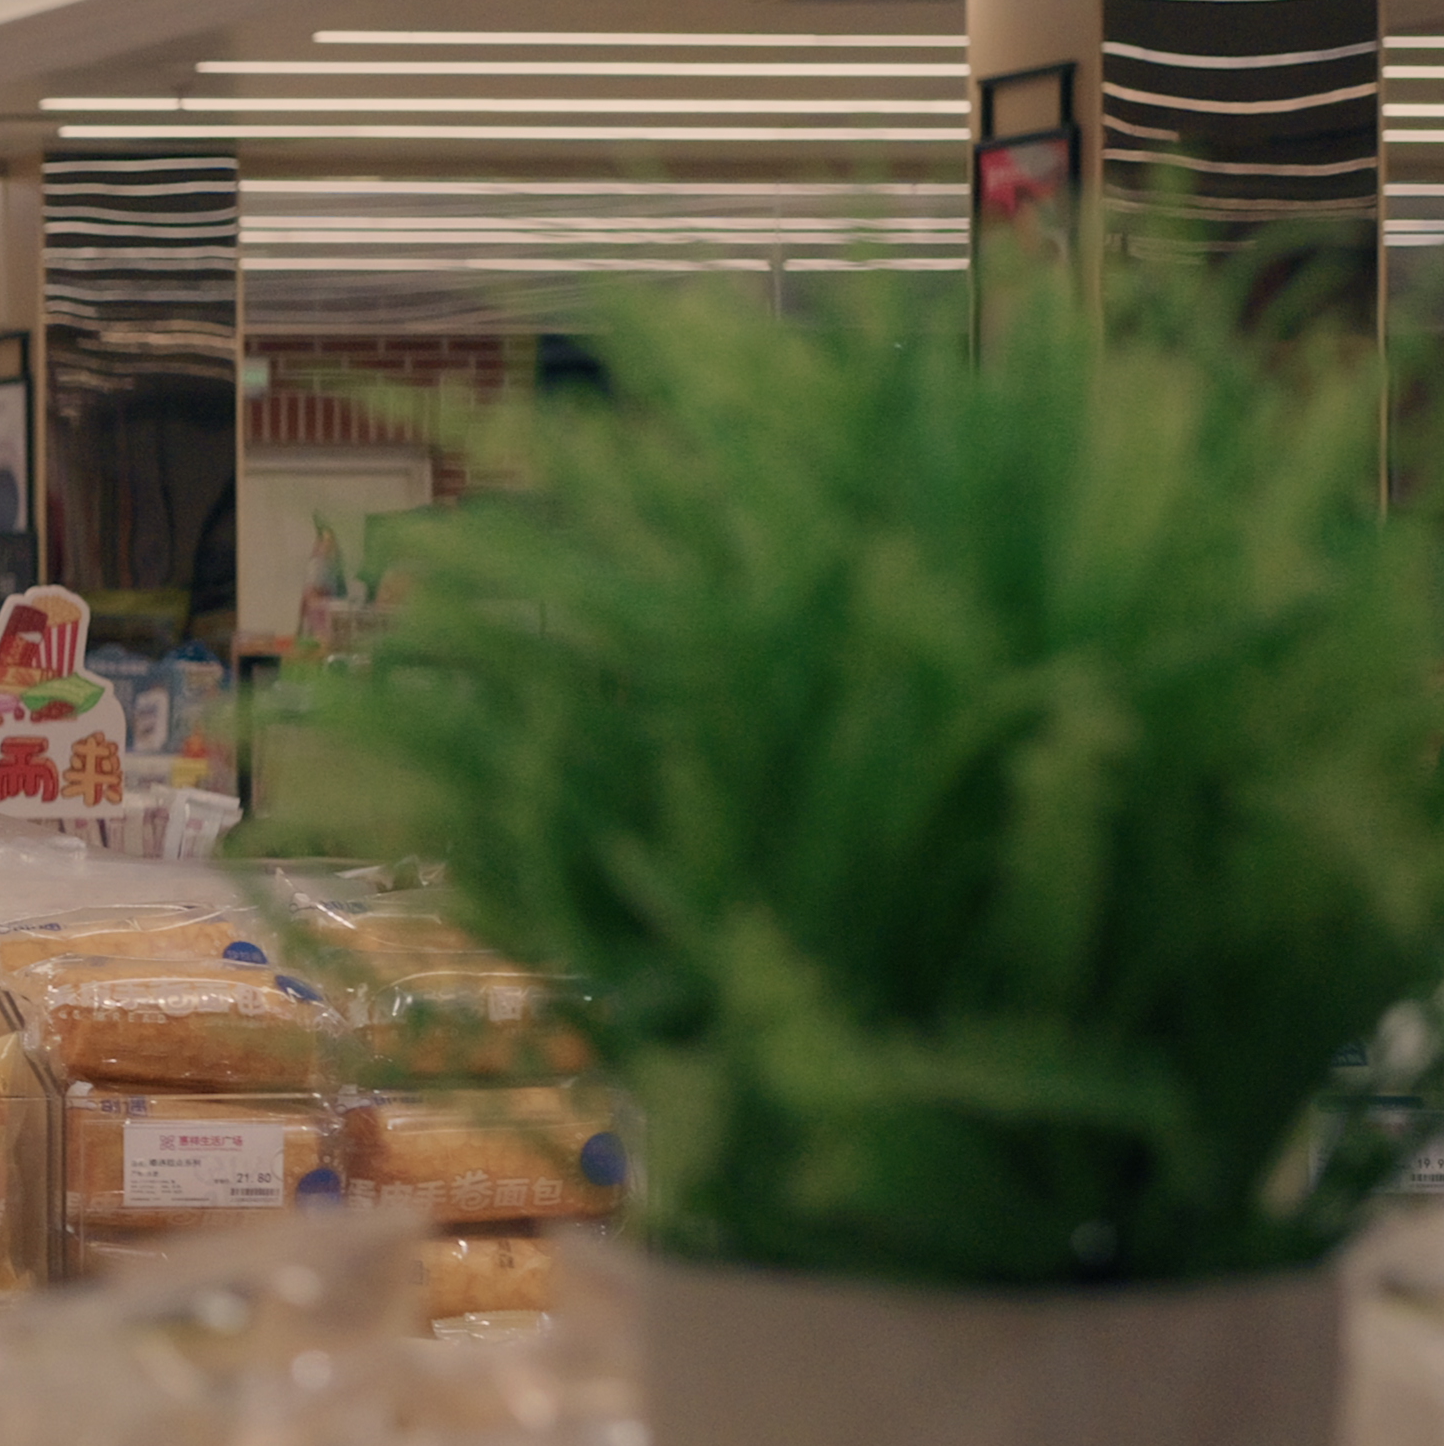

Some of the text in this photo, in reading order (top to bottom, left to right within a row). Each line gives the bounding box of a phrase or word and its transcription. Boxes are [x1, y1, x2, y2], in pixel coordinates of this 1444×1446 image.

[178, 1135, 243, 1147] 惠祥生活广场
[236, 1172, 273, 1184] 21.80
